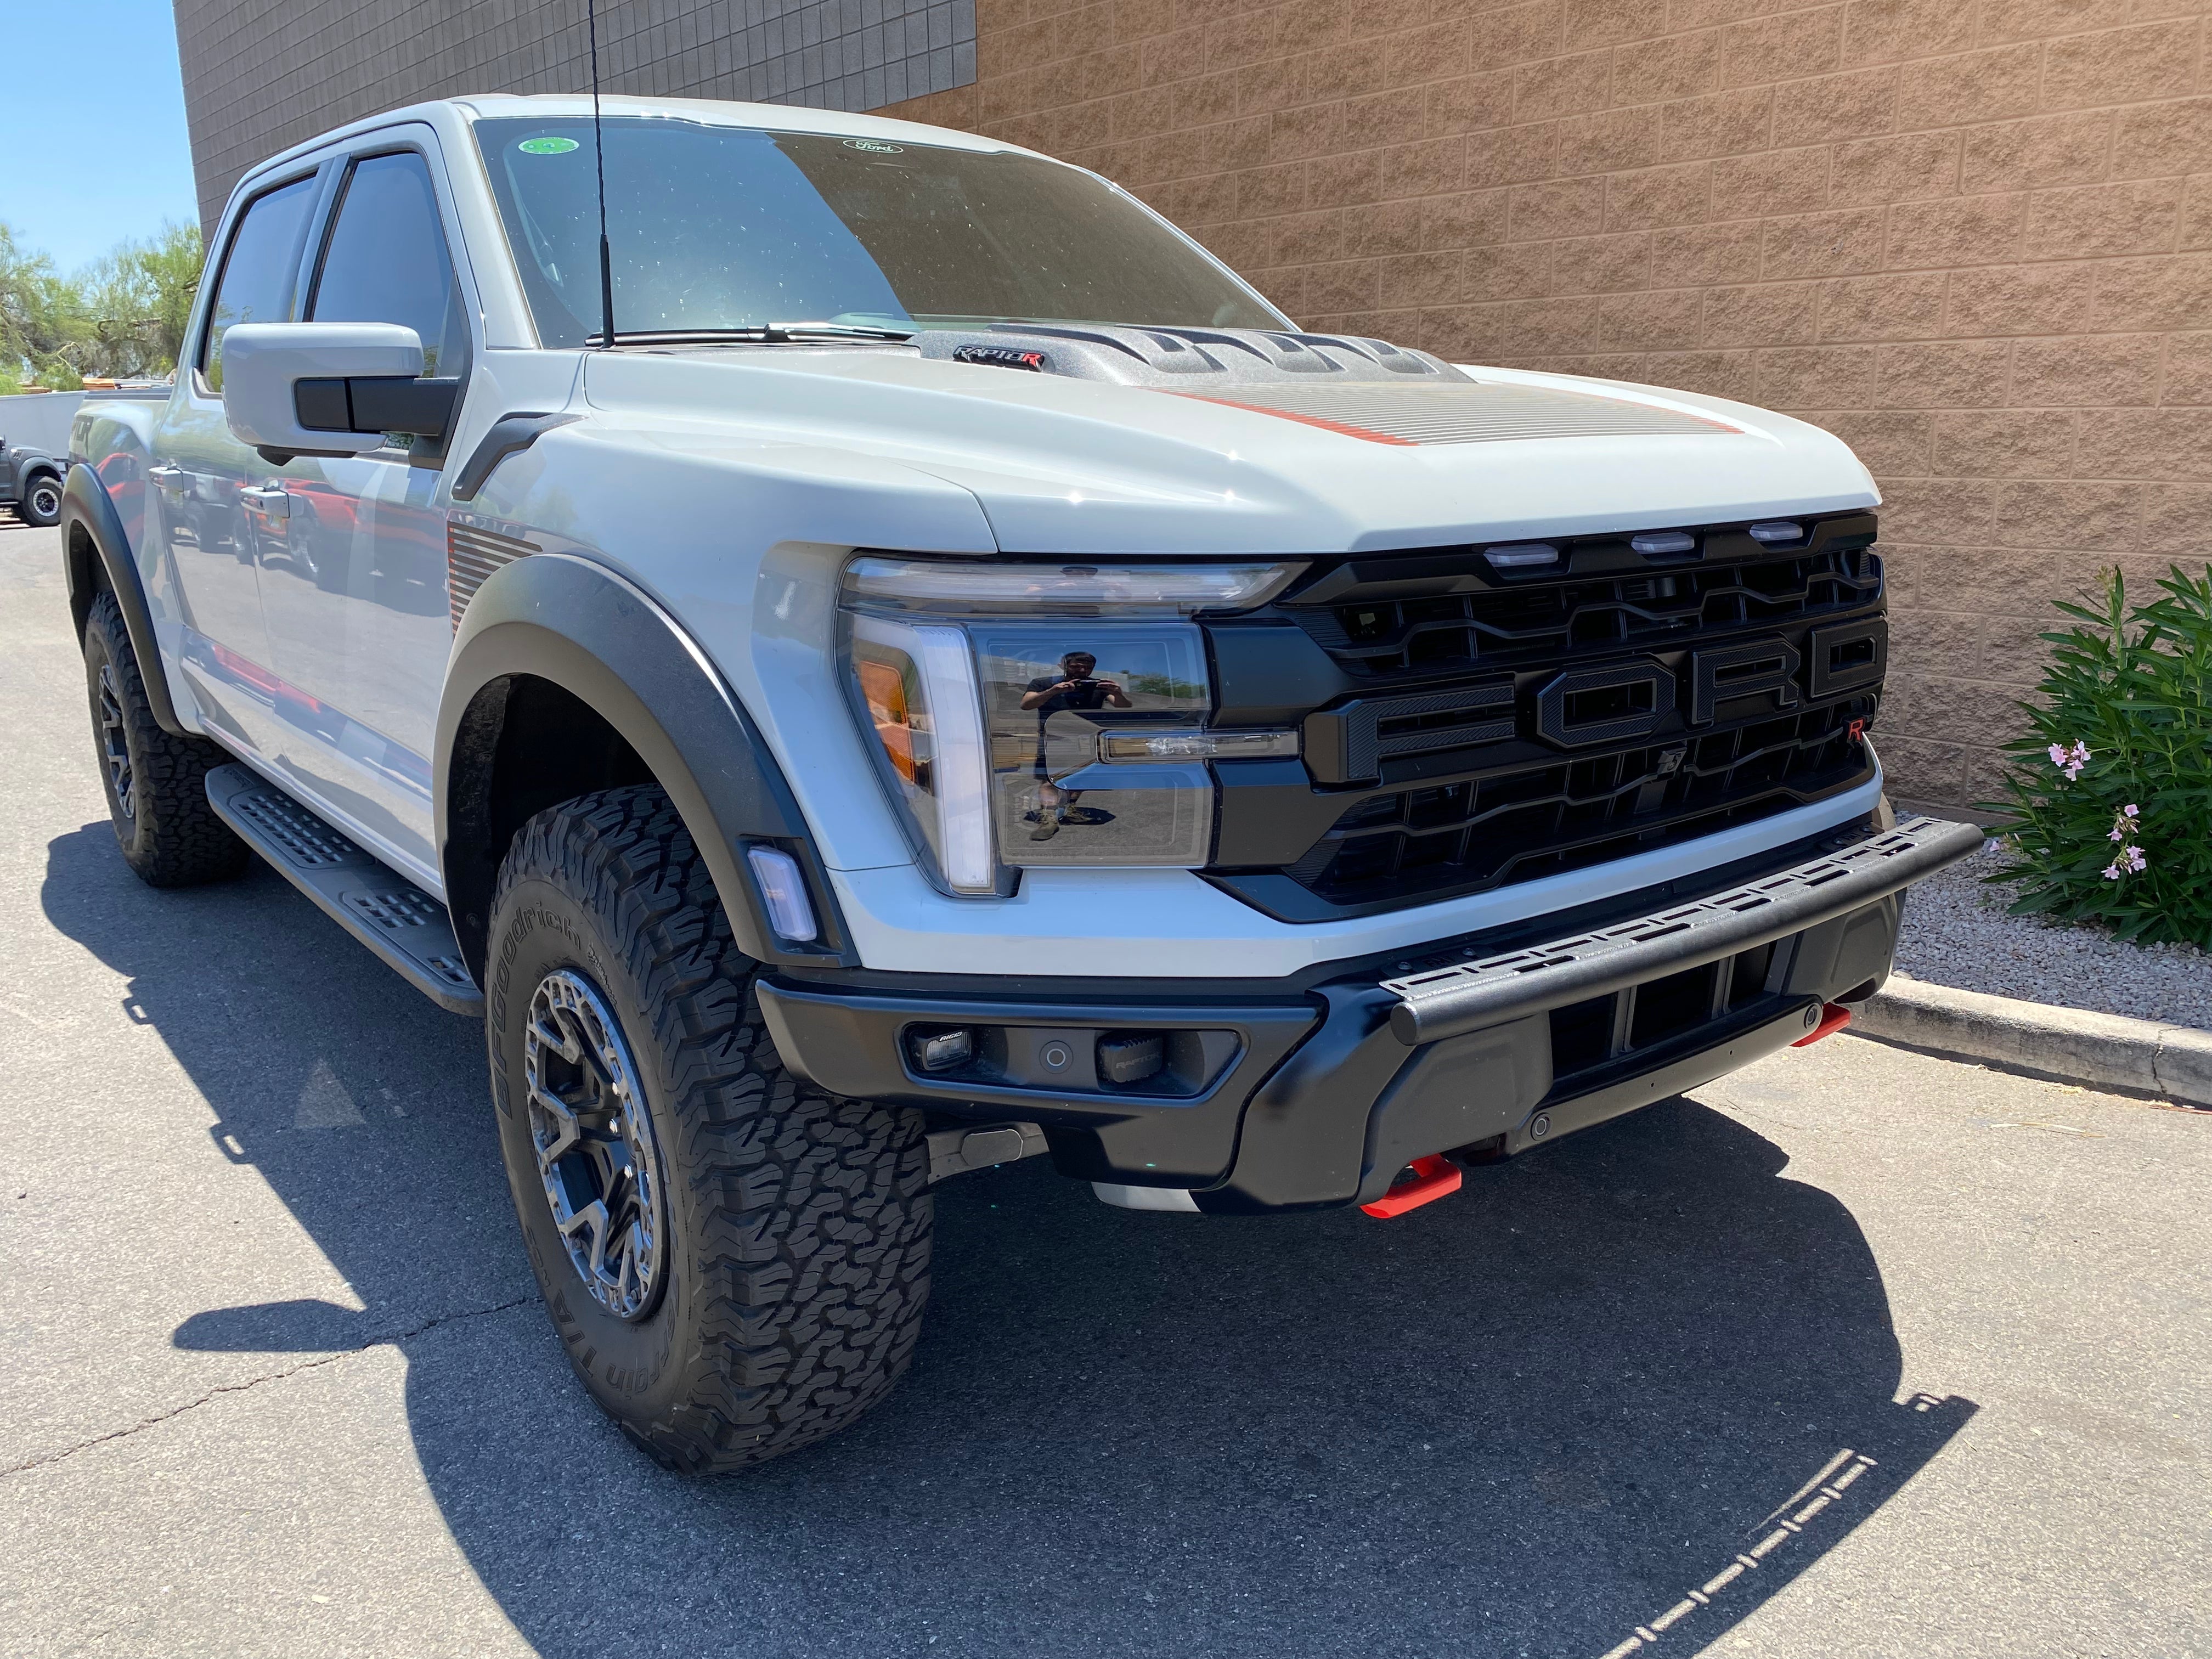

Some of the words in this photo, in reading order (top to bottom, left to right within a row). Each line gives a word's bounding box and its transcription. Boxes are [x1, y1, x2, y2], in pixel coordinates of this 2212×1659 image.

[855, 140, 894, 152] Ford
[953, 345, 1042, 370] RAPTOR
[1343, 616, 1887, 781] FORD
[1848, 718, 1864, 742] R
[490, 901, 582, 1120] BFGoodrich
[939, 1031, 963, 1042] RIGID
